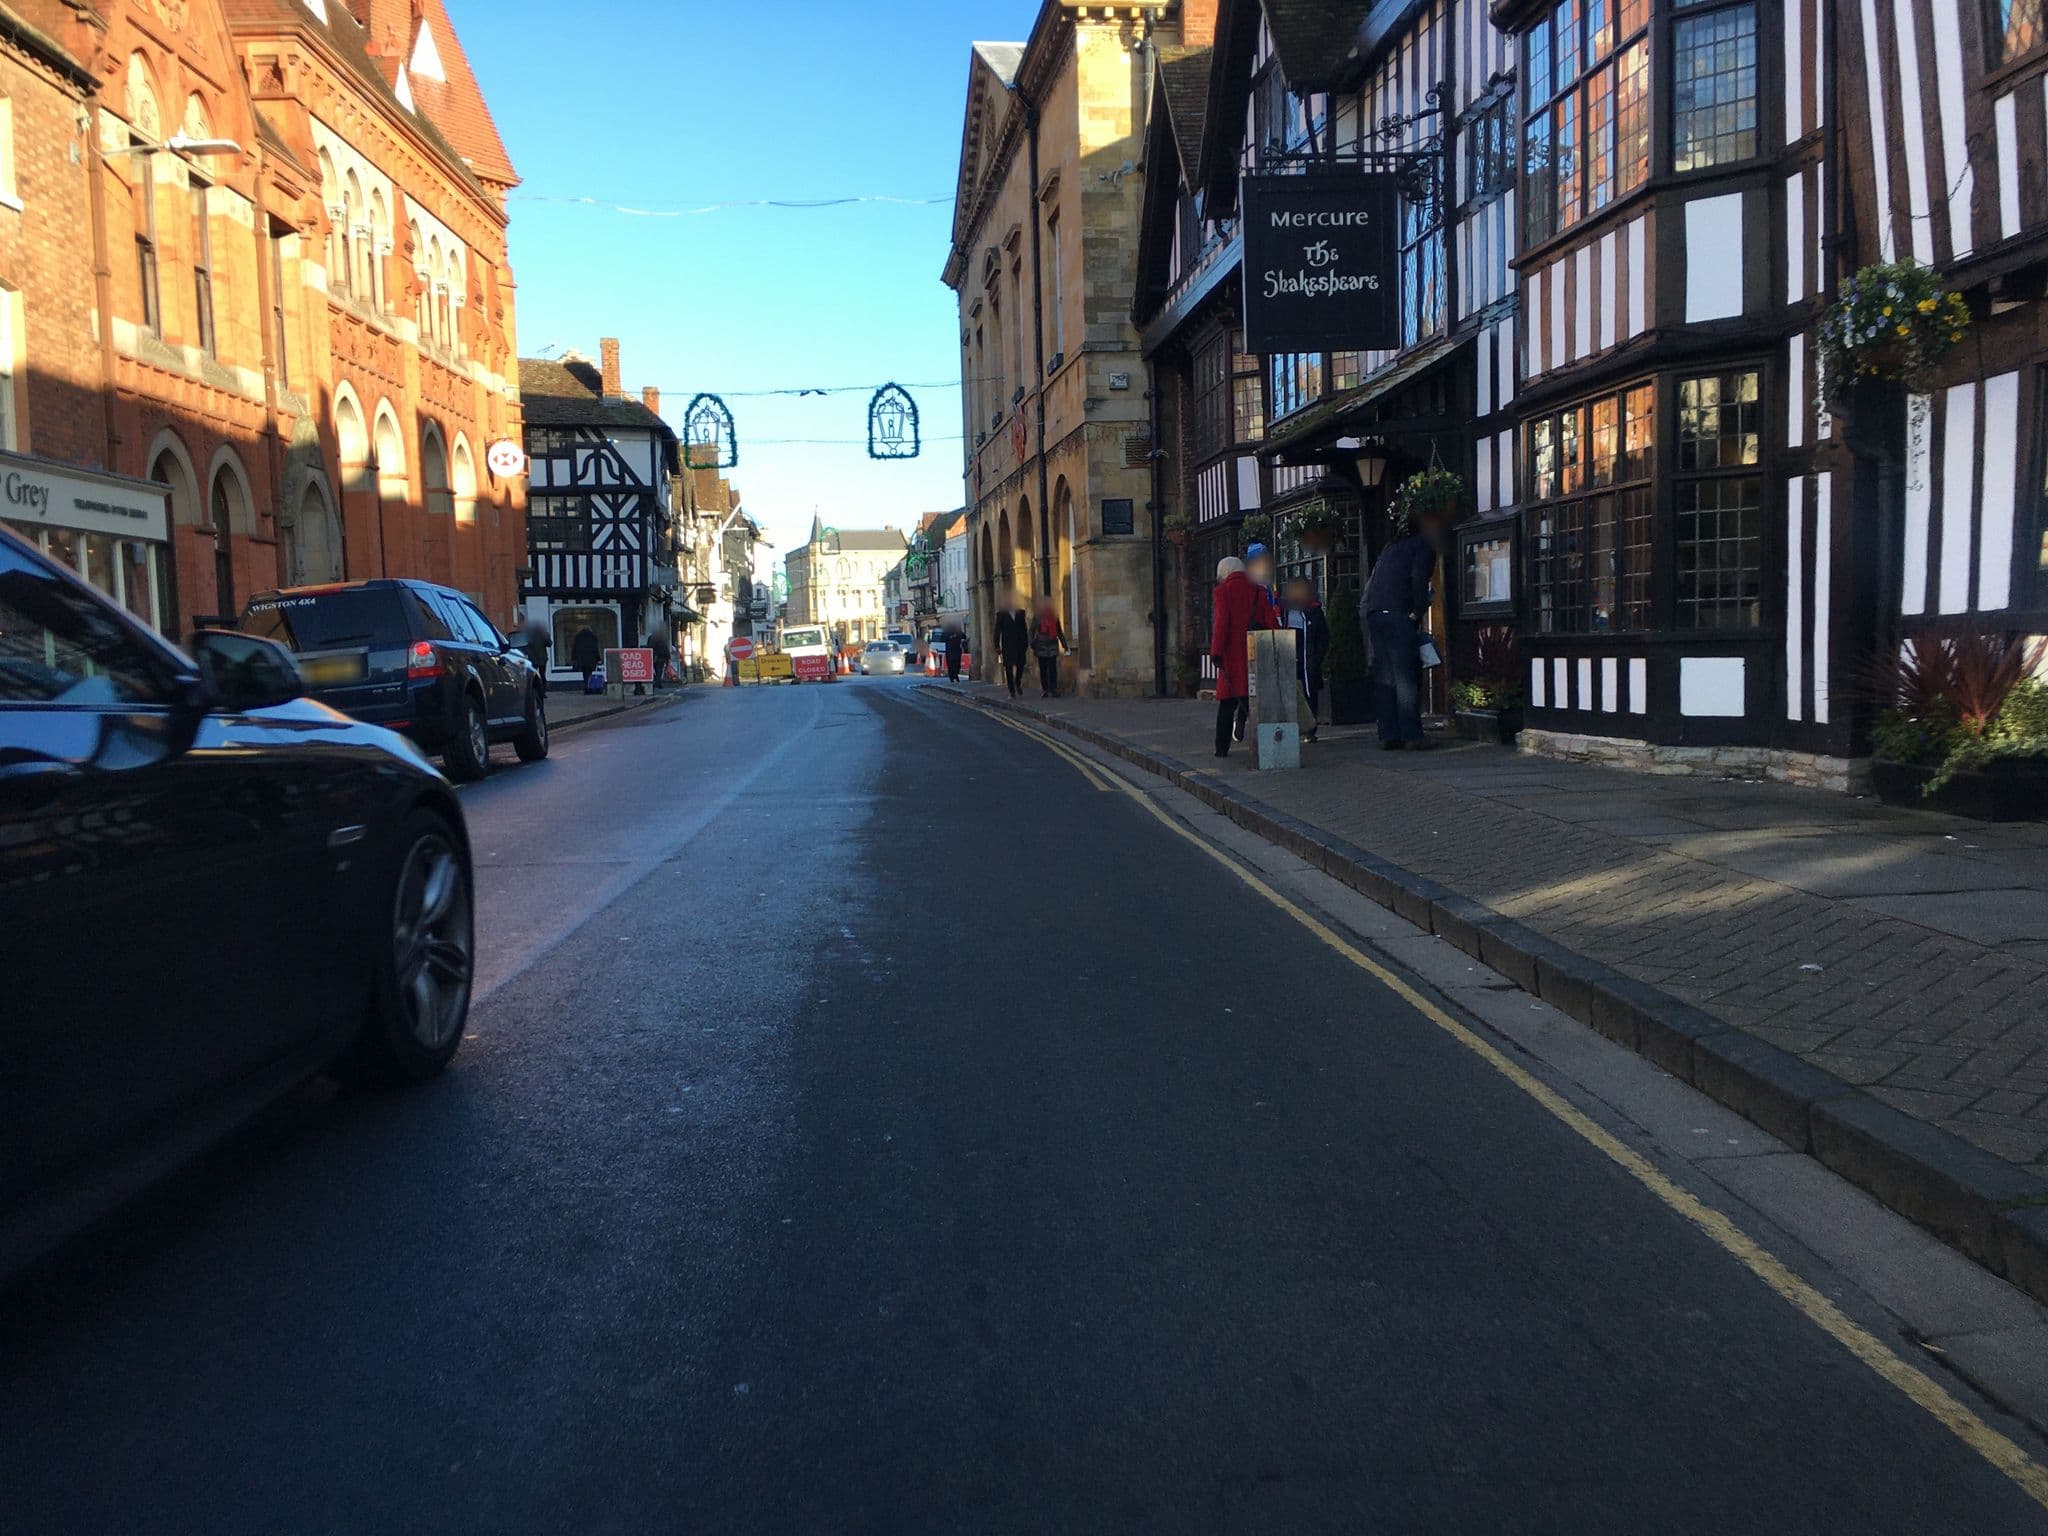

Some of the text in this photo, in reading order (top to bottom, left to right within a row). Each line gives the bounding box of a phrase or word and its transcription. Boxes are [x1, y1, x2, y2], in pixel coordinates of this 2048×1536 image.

[1271, 211, 1369, 227] Mercure
[1303, 239, 1339, 267] The
[1263, 268, 1379, 298] Shakespeare
[6, 472, 50, 516] Grey
[251, 599, 297, 612] WIGSTON
[621, 652, 642, 660] OAD
[798, 666, 826, 674] CLOSED
